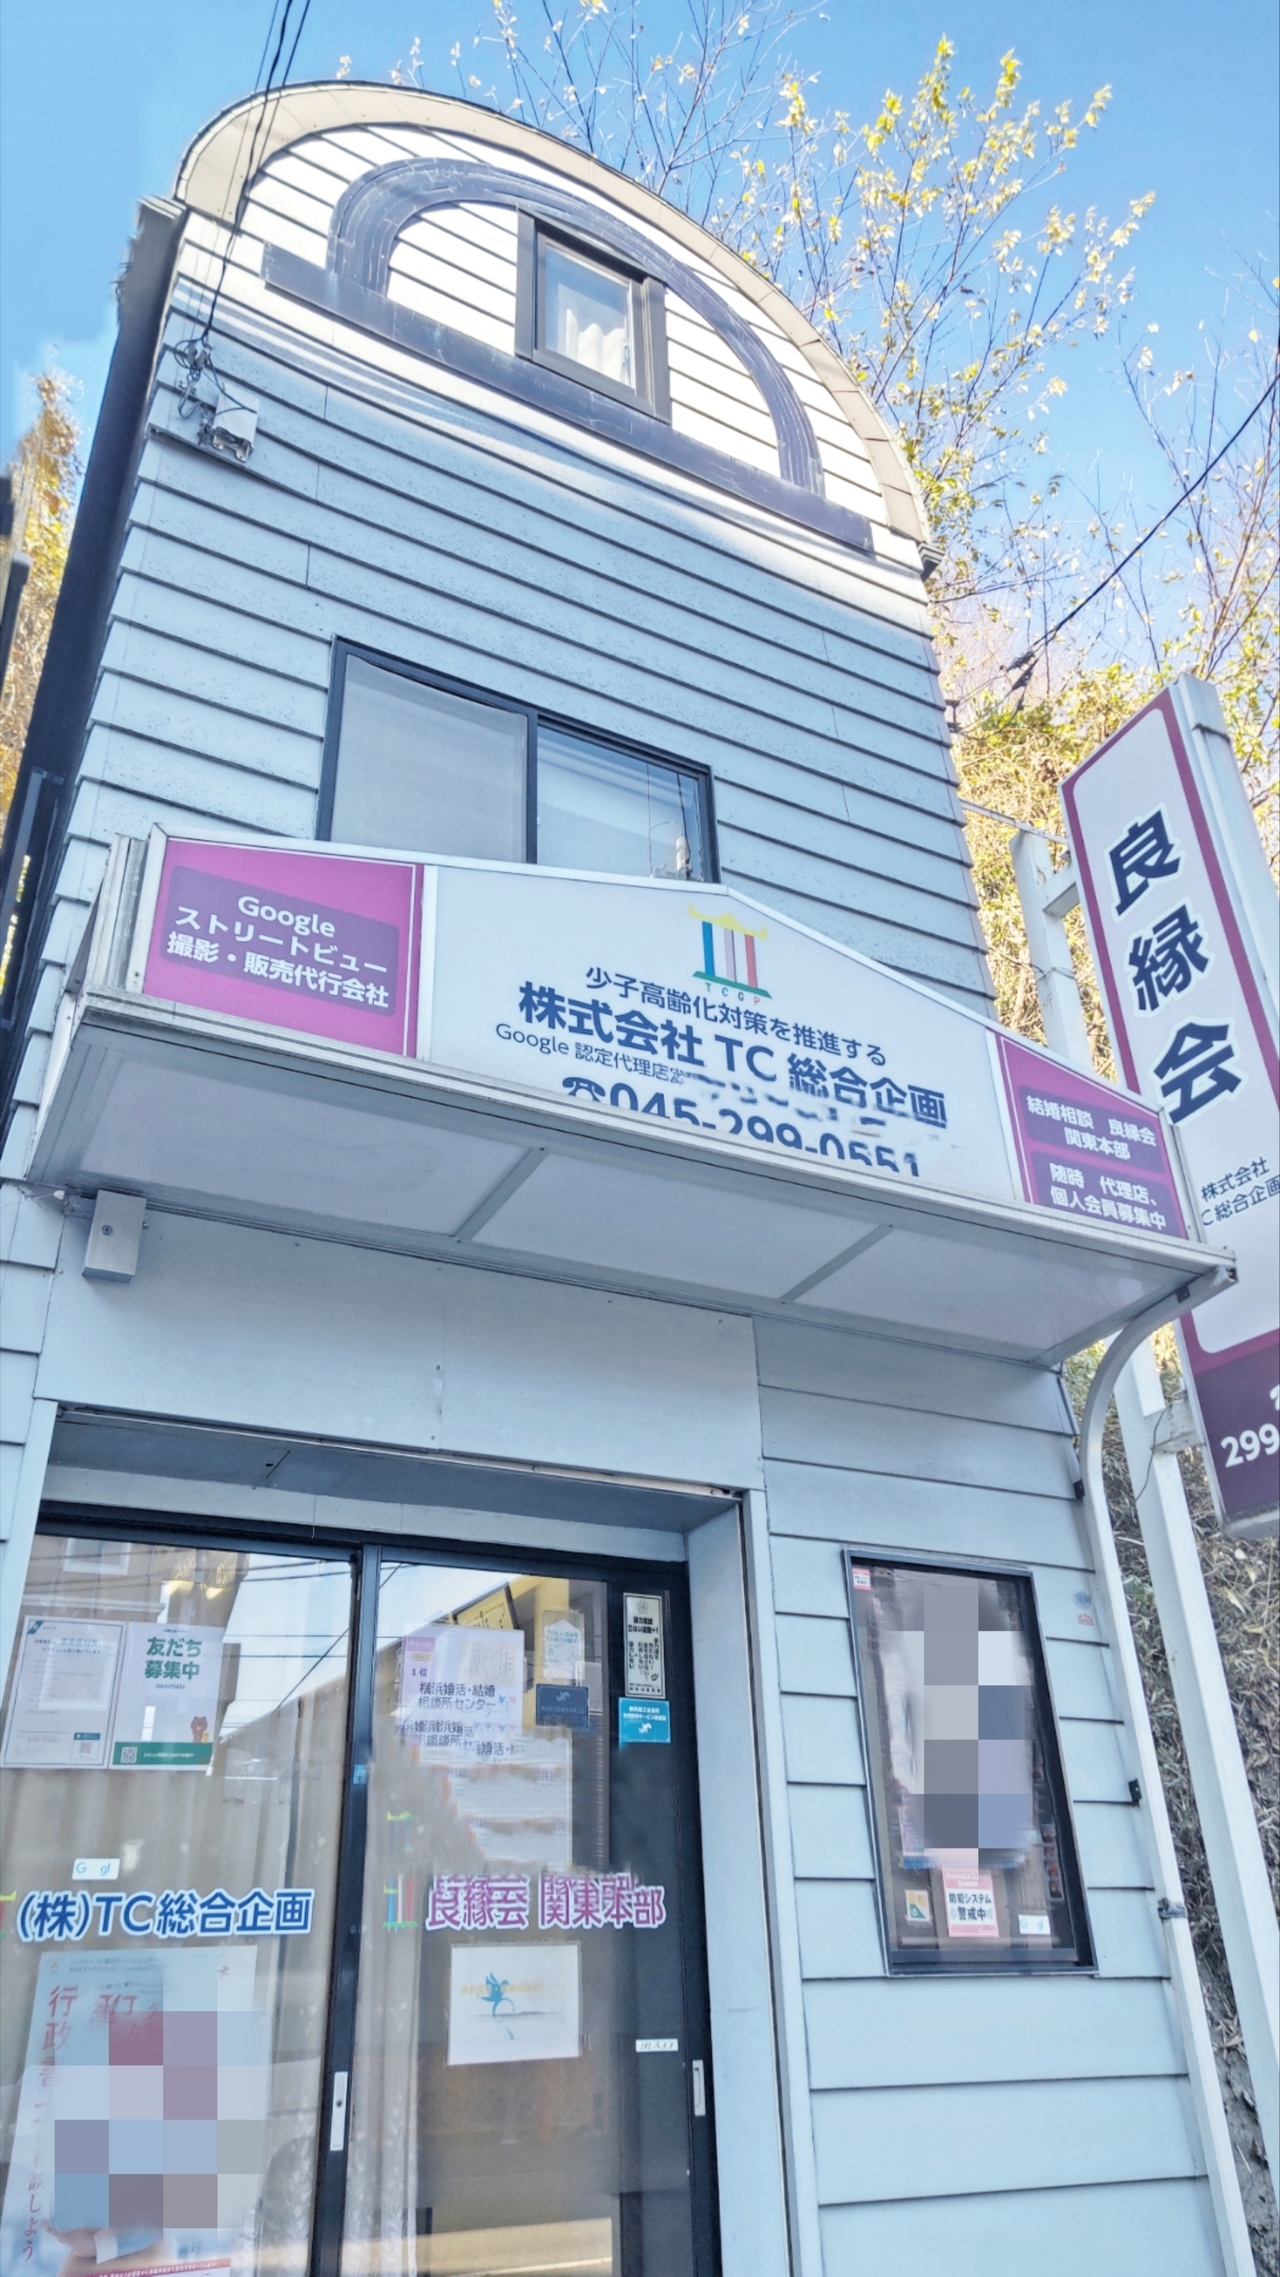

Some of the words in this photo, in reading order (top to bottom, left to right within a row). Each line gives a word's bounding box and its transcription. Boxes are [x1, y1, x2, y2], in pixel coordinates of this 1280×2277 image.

[237, 895, 336, 938] Google
[174, 905, 388, 973] ストリートビュー
[166, 931, 389, 1008] 撮影・販売代行会社
[1108, 808, 1243, 1126] 良縁会
[585, 966, 887, 1067] 少子高齢化対策を推進する
[495, 1022, 570, 1055] Google
[1026, 1095, 1095, 1130] 結婚相談
[1063, 1126, 1131, 1160] 関東本部
[1049, 1162, 1085, 1189] 随時
[1200, 1155, 1271, 1203] 株式会社
[1050, 1185, 1167, 1231] 個人会員募集中
[146, 1636, 203, 1658] 友だち
[144, 1659, 200, 1681] 募集中
